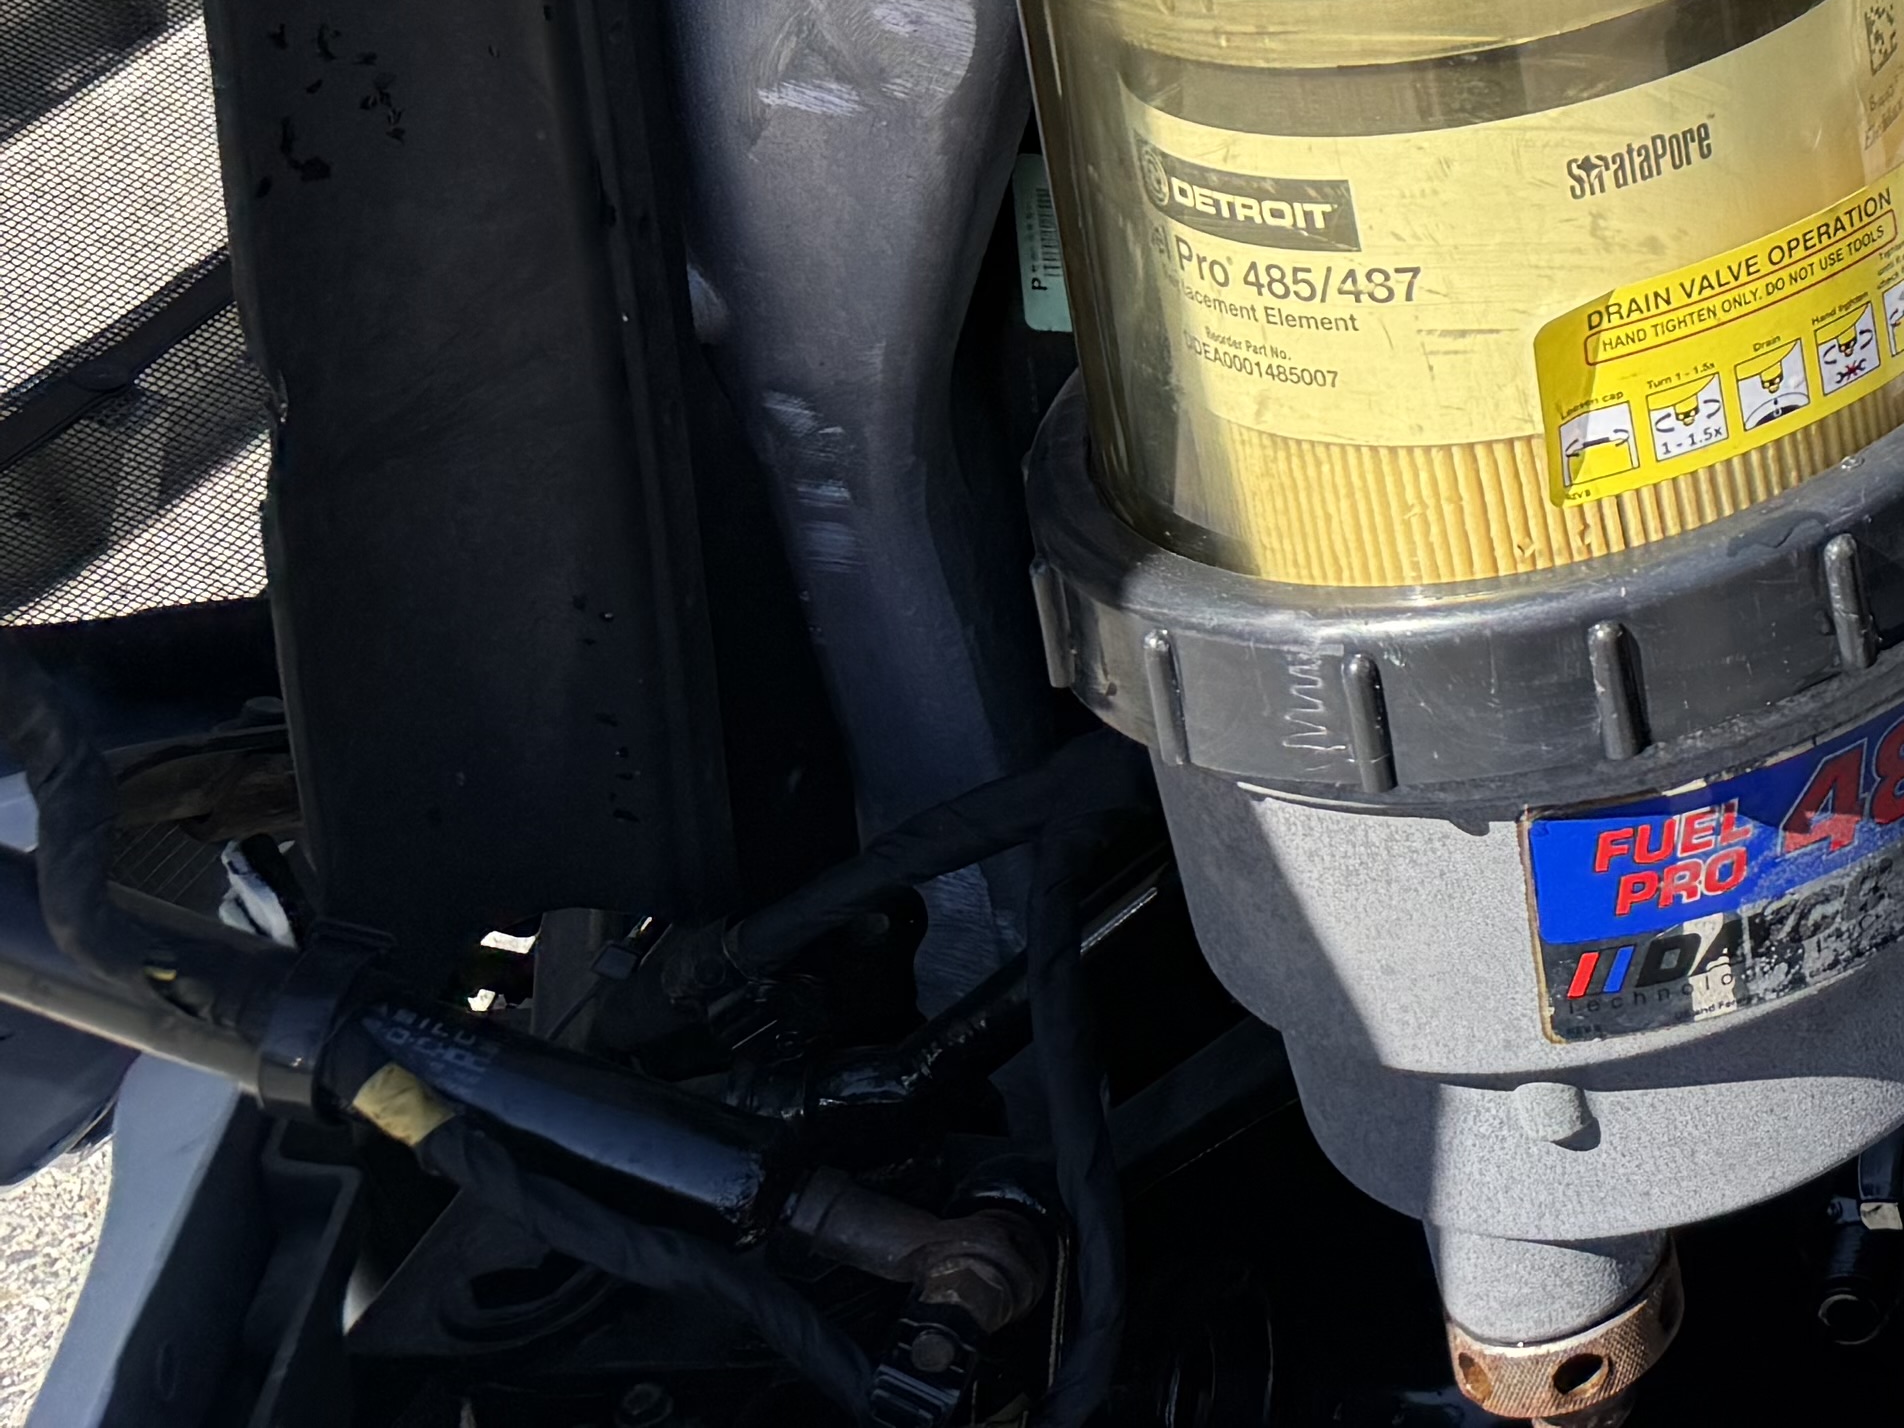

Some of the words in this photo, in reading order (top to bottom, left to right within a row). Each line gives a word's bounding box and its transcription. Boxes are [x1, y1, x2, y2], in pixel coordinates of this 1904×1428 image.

[1566, 121, 1712, 202] StrataPore
[1170, 176, 1333, 229] DETROIT
[1175, 235, 1230, 288] Pro
[1242, 260, 1421, 304] 485/487
[1586, 287, 1672, 332] DRAIN
[1680, 254, 1761, 300] VALVE
[1768, 187, 1893, 266] OPERATION
[1602, 328, 1648, 352] HAND
[1652, 305, 1718, 339] TIGHTEN
[1721, 287, 1763, 321] ONLY.
[1765, 277, 1785, 298] DO
[1788, 262, 1816, 290] NOT
[1818, 248, 1845, 272] USE
[1847, 225, 1885, 264] TOOLS
[1264, 306, 1360, 333] Element
[1811, 304, 1838, 326] Hand
[1245, 341, 1269, 357] Part
[1270, 346, 1291, 361] No.
[1753, 335, 1782, 352] Drain
[1646, 375, 1673, 389] Turn
[1693, 361, 1716, 377] 1.5x
[1599, 390, 1624, 405] cap
[1688, 426, 1723, 445] 1.5x
[1593, 798, 1754, 874] FUEL
[1614, 844, 1750, 918] PRO
